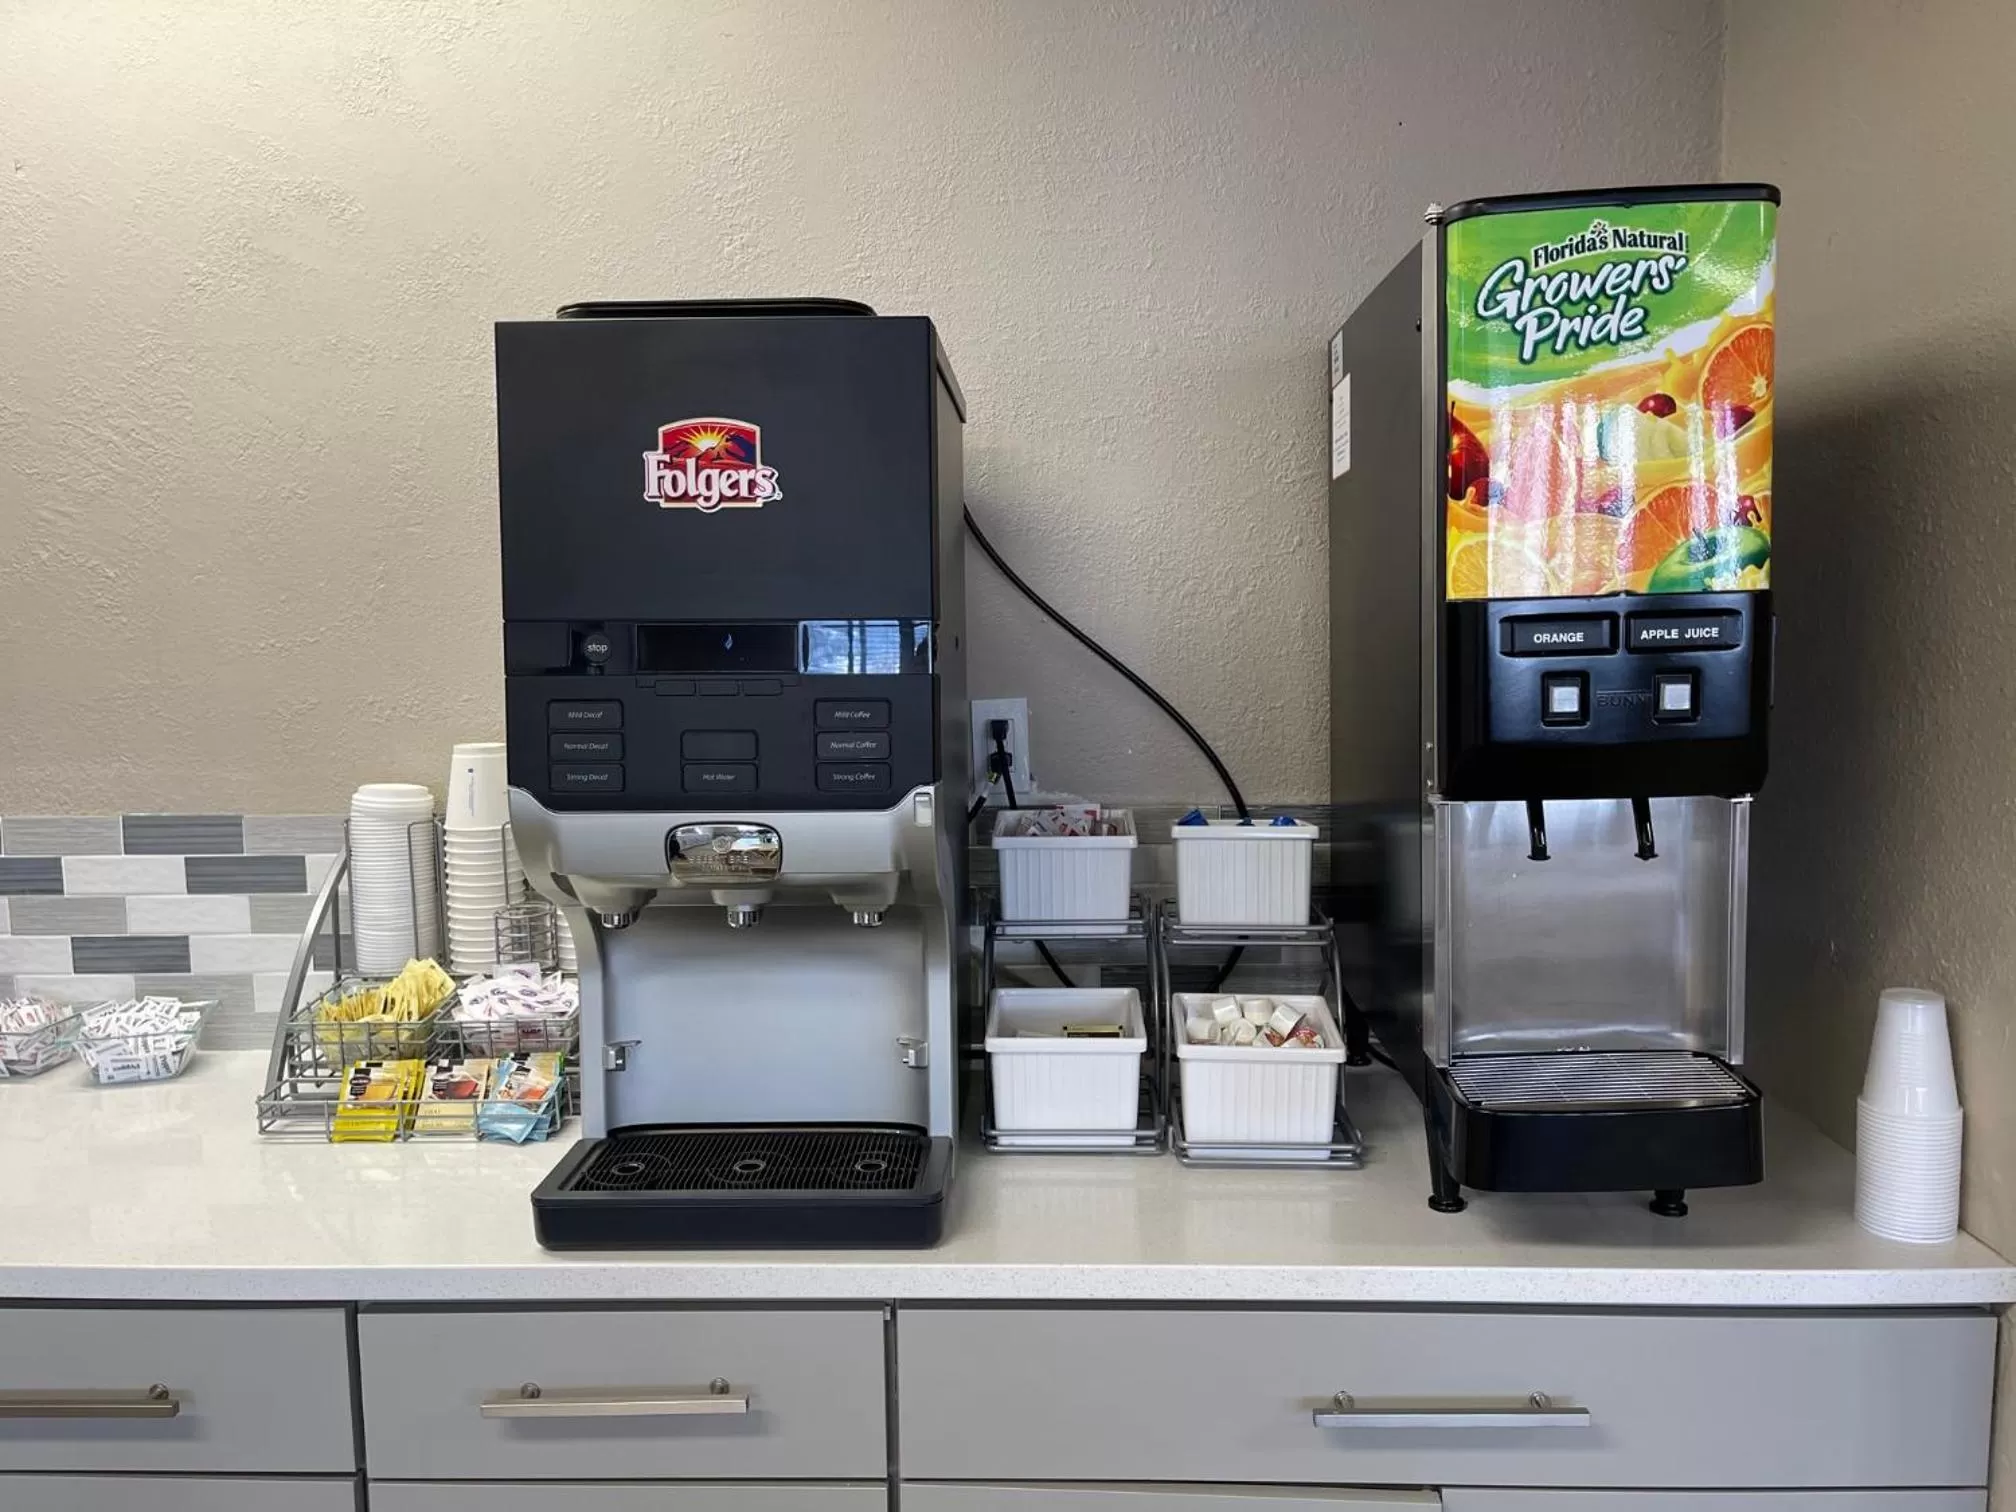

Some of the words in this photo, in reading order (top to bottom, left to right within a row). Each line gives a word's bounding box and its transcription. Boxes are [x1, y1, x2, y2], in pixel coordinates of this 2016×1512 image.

[1513, 293, 1647, 361] Pride
[646, 454, 775, 508] Folgers
[1533, 632, 1585, 644] ORANGE
[1640, 628, 1679, 640] APPLE
[1684, 627, 1720, 639] JUICE
[587, 643, 609, 654] stop
